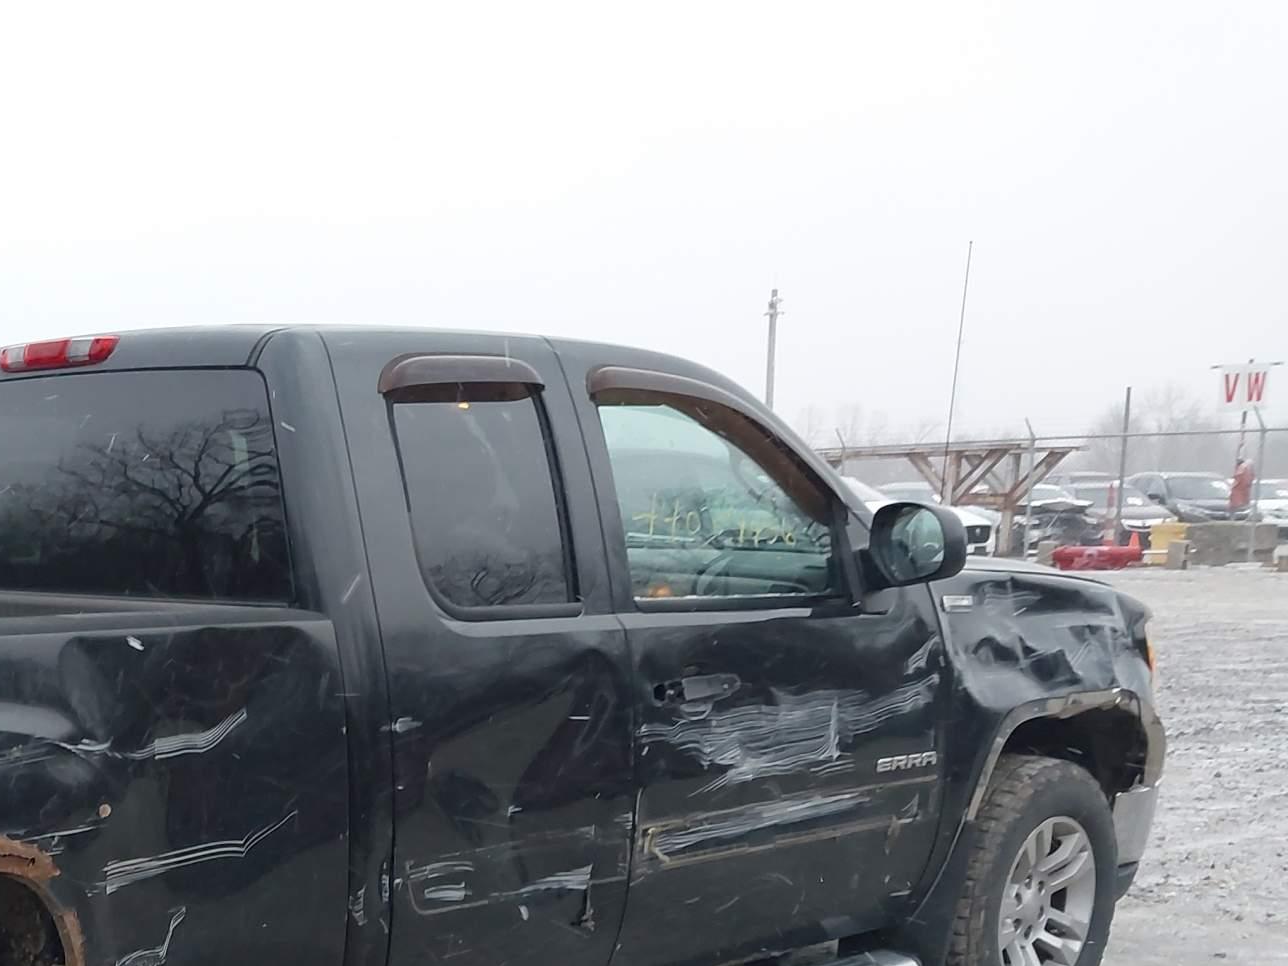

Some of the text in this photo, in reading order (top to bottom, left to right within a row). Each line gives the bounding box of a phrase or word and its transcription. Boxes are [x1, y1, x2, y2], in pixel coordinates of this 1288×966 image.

[1225, 372, 1267, 403] V W
[876, 751, 937, 773] ERRA
